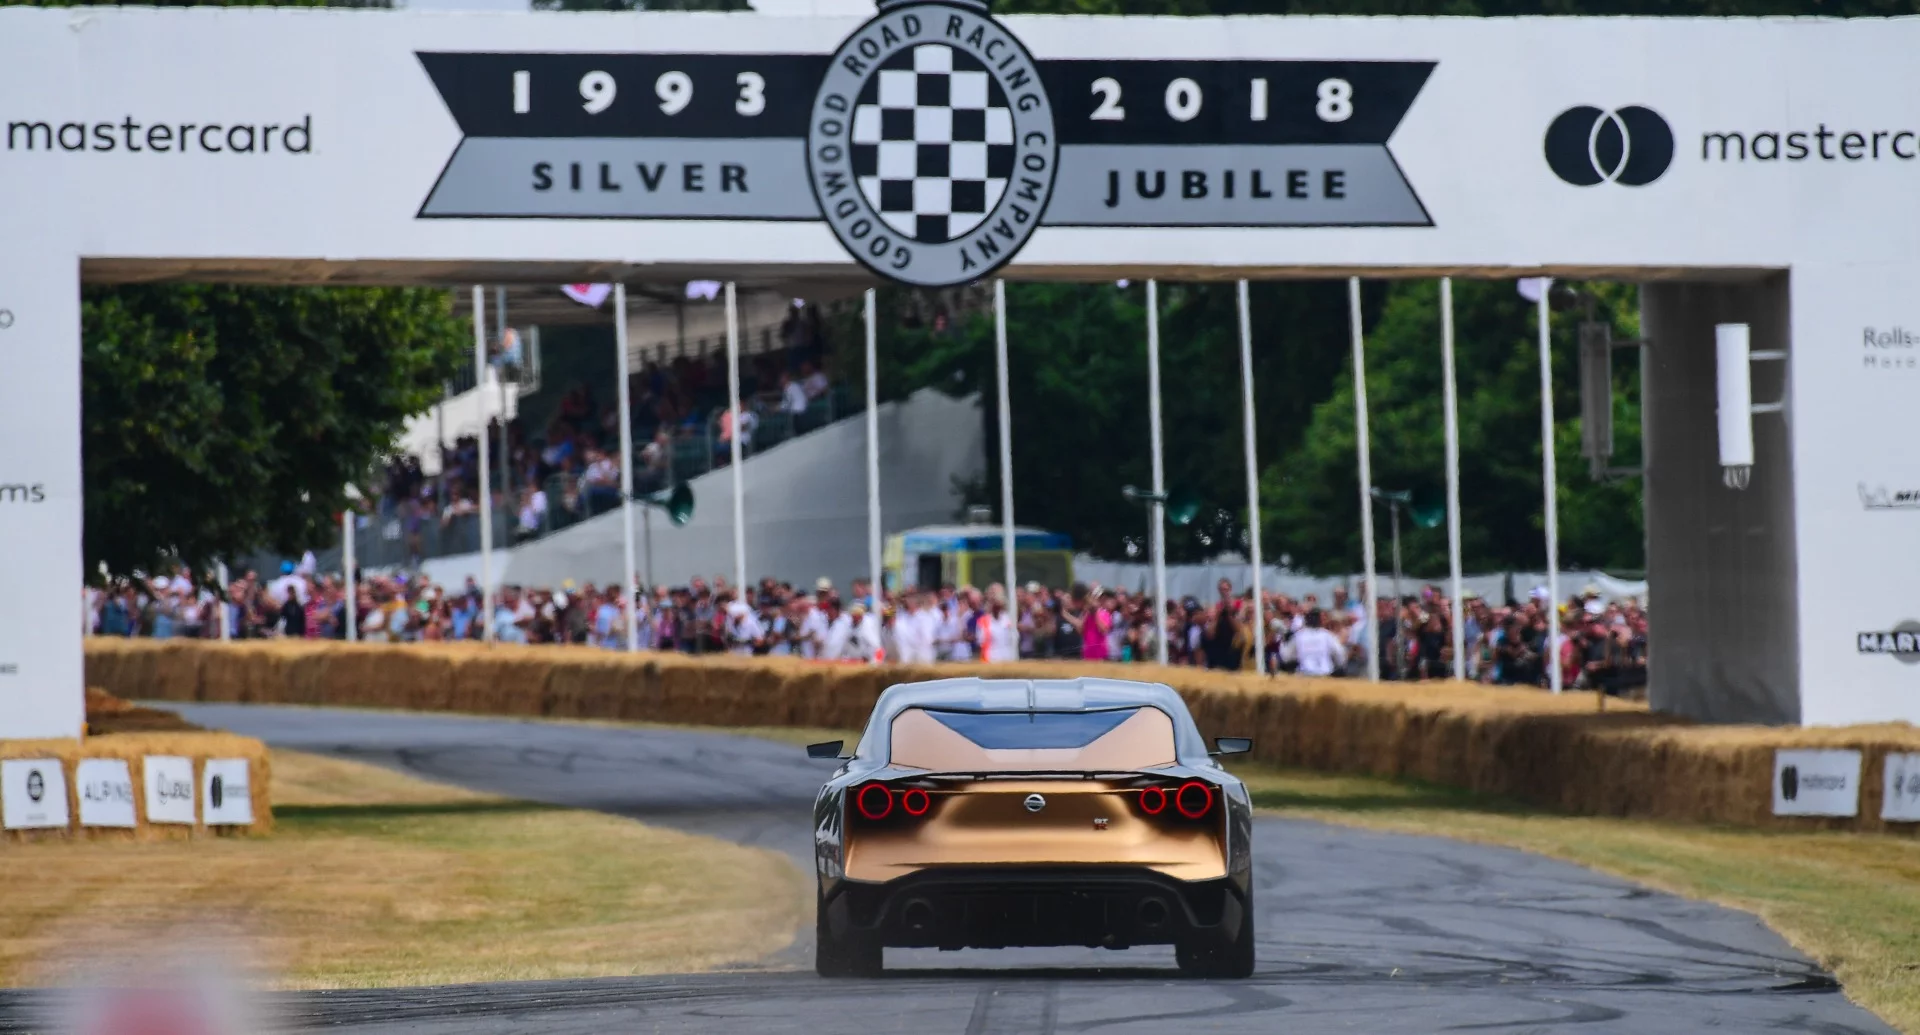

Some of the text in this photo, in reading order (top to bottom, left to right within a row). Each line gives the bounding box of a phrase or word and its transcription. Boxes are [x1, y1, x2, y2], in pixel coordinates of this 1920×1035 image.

[513, 70, 1353, 122] 1993 2018
[7, 115, 312, 153] mastercard
[819, 13, 1046, 272] GOODWOOD ROAD RACING COMPANY
[1702, 124, 1920, 161] masterc
[532, 161, 1346, 208] SILVER JUBILEE
